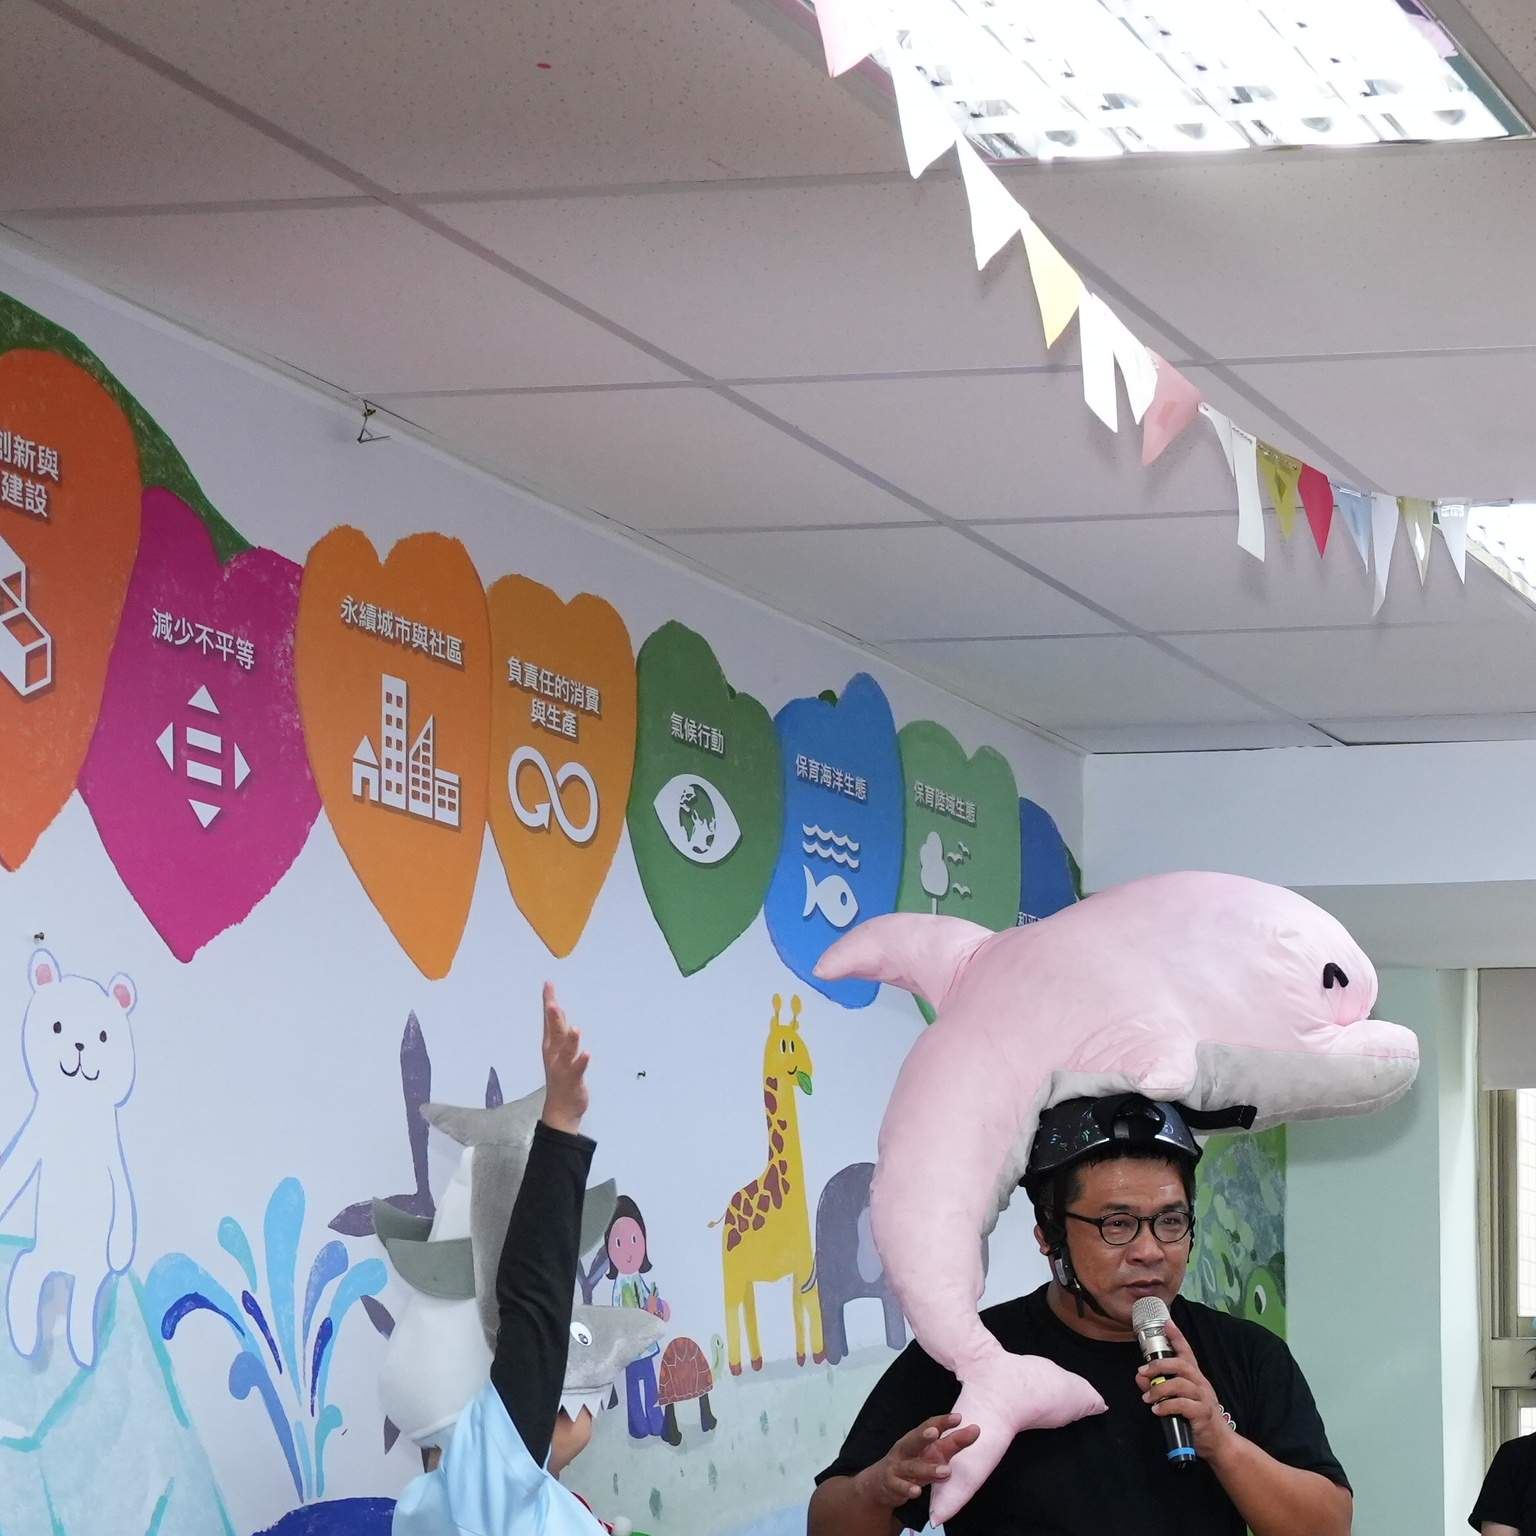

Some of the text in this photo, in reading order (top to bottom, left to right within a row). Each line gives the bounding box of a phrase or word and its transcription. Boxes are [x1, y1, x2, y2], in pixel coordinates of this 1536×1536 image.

[1, 471, 48, 517] 建設
[151, 607, 256, 671] 減少不平等
[340, 595, 464, 665] 永續城市與社區
[508, 656, 600, 714] 負責任的消費
[531, 698, 577, 738] 與生產
[671, 711, 723, 754] 氣候行動
[796, 753, 867, 801] 保育海洋生態
[914, 780, 977, 824] 保育陸域生態
